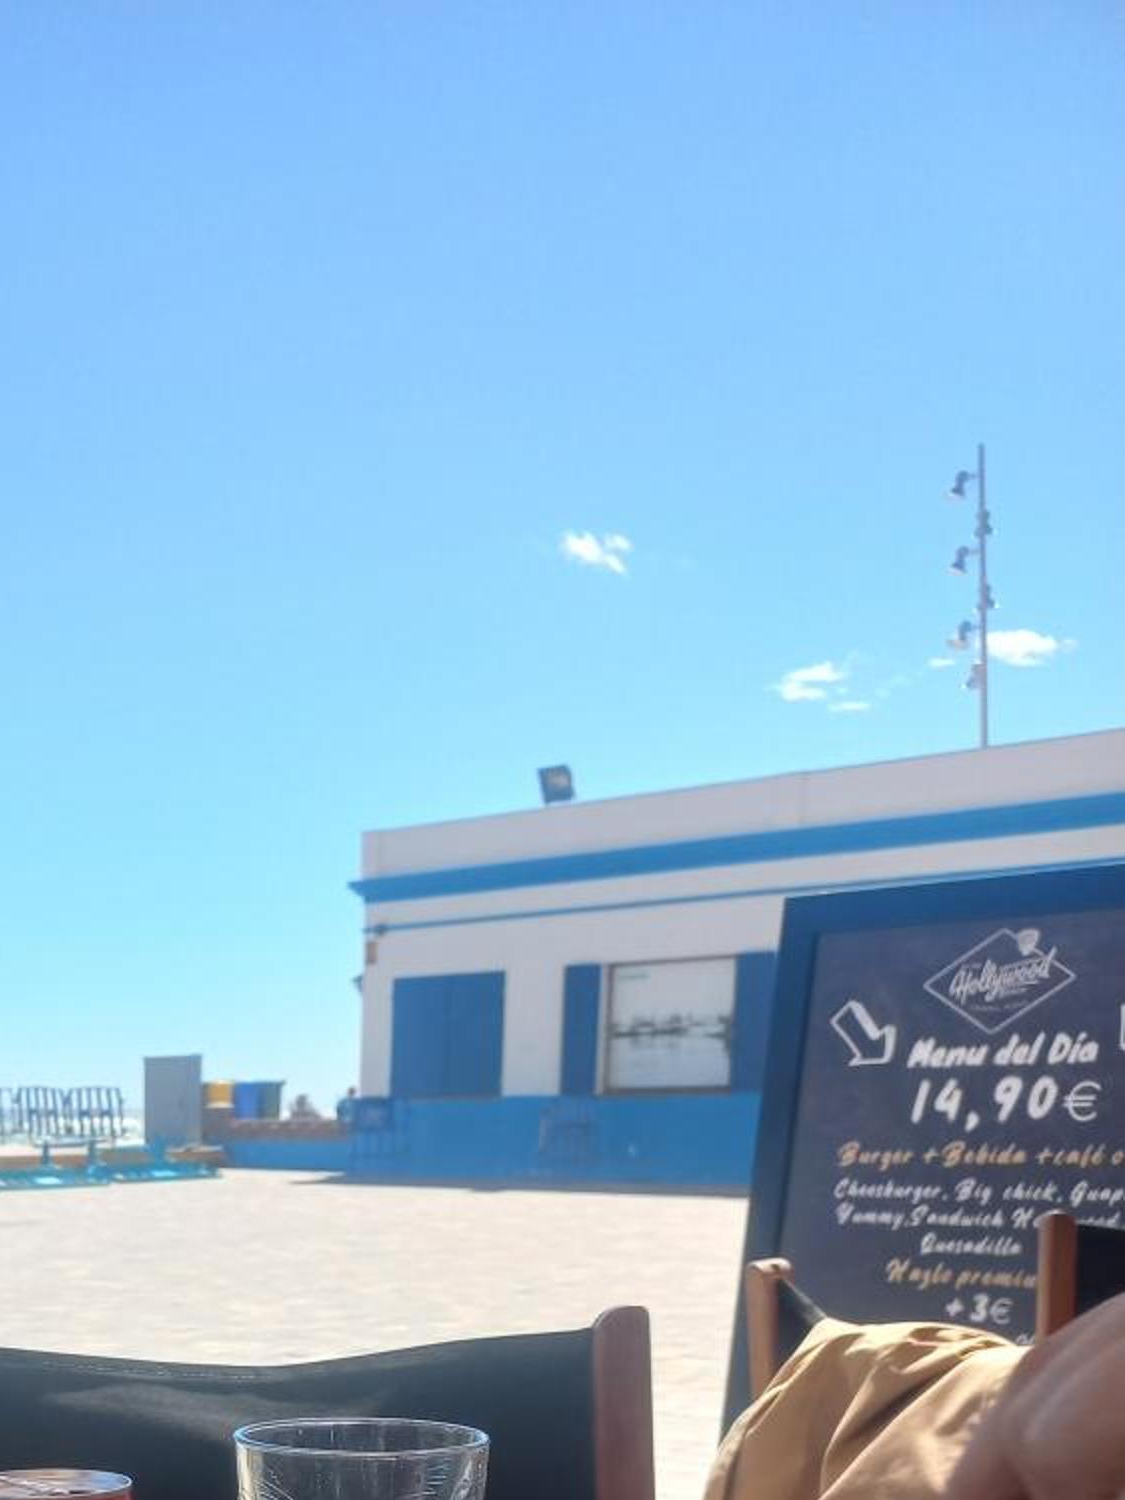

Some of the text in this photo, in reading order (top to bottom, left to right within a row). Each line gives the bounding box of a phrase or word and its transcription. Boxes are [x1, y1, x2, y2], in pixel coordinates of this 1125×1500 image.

[993, 1031, 1046, 1066] del
[1047, 1031, 1099, 1065] Día
[837, 1141, 914, 1170] Burger
[942, 1141, 1026, 1168] Bebida
[953, 1178, 993, 1205] Big
[1069, 1180, 1125, 1207] Guap
[920, 1232, 1022, 1256] Quesadilla
[954, 1268, 1038, 1289] premiu
